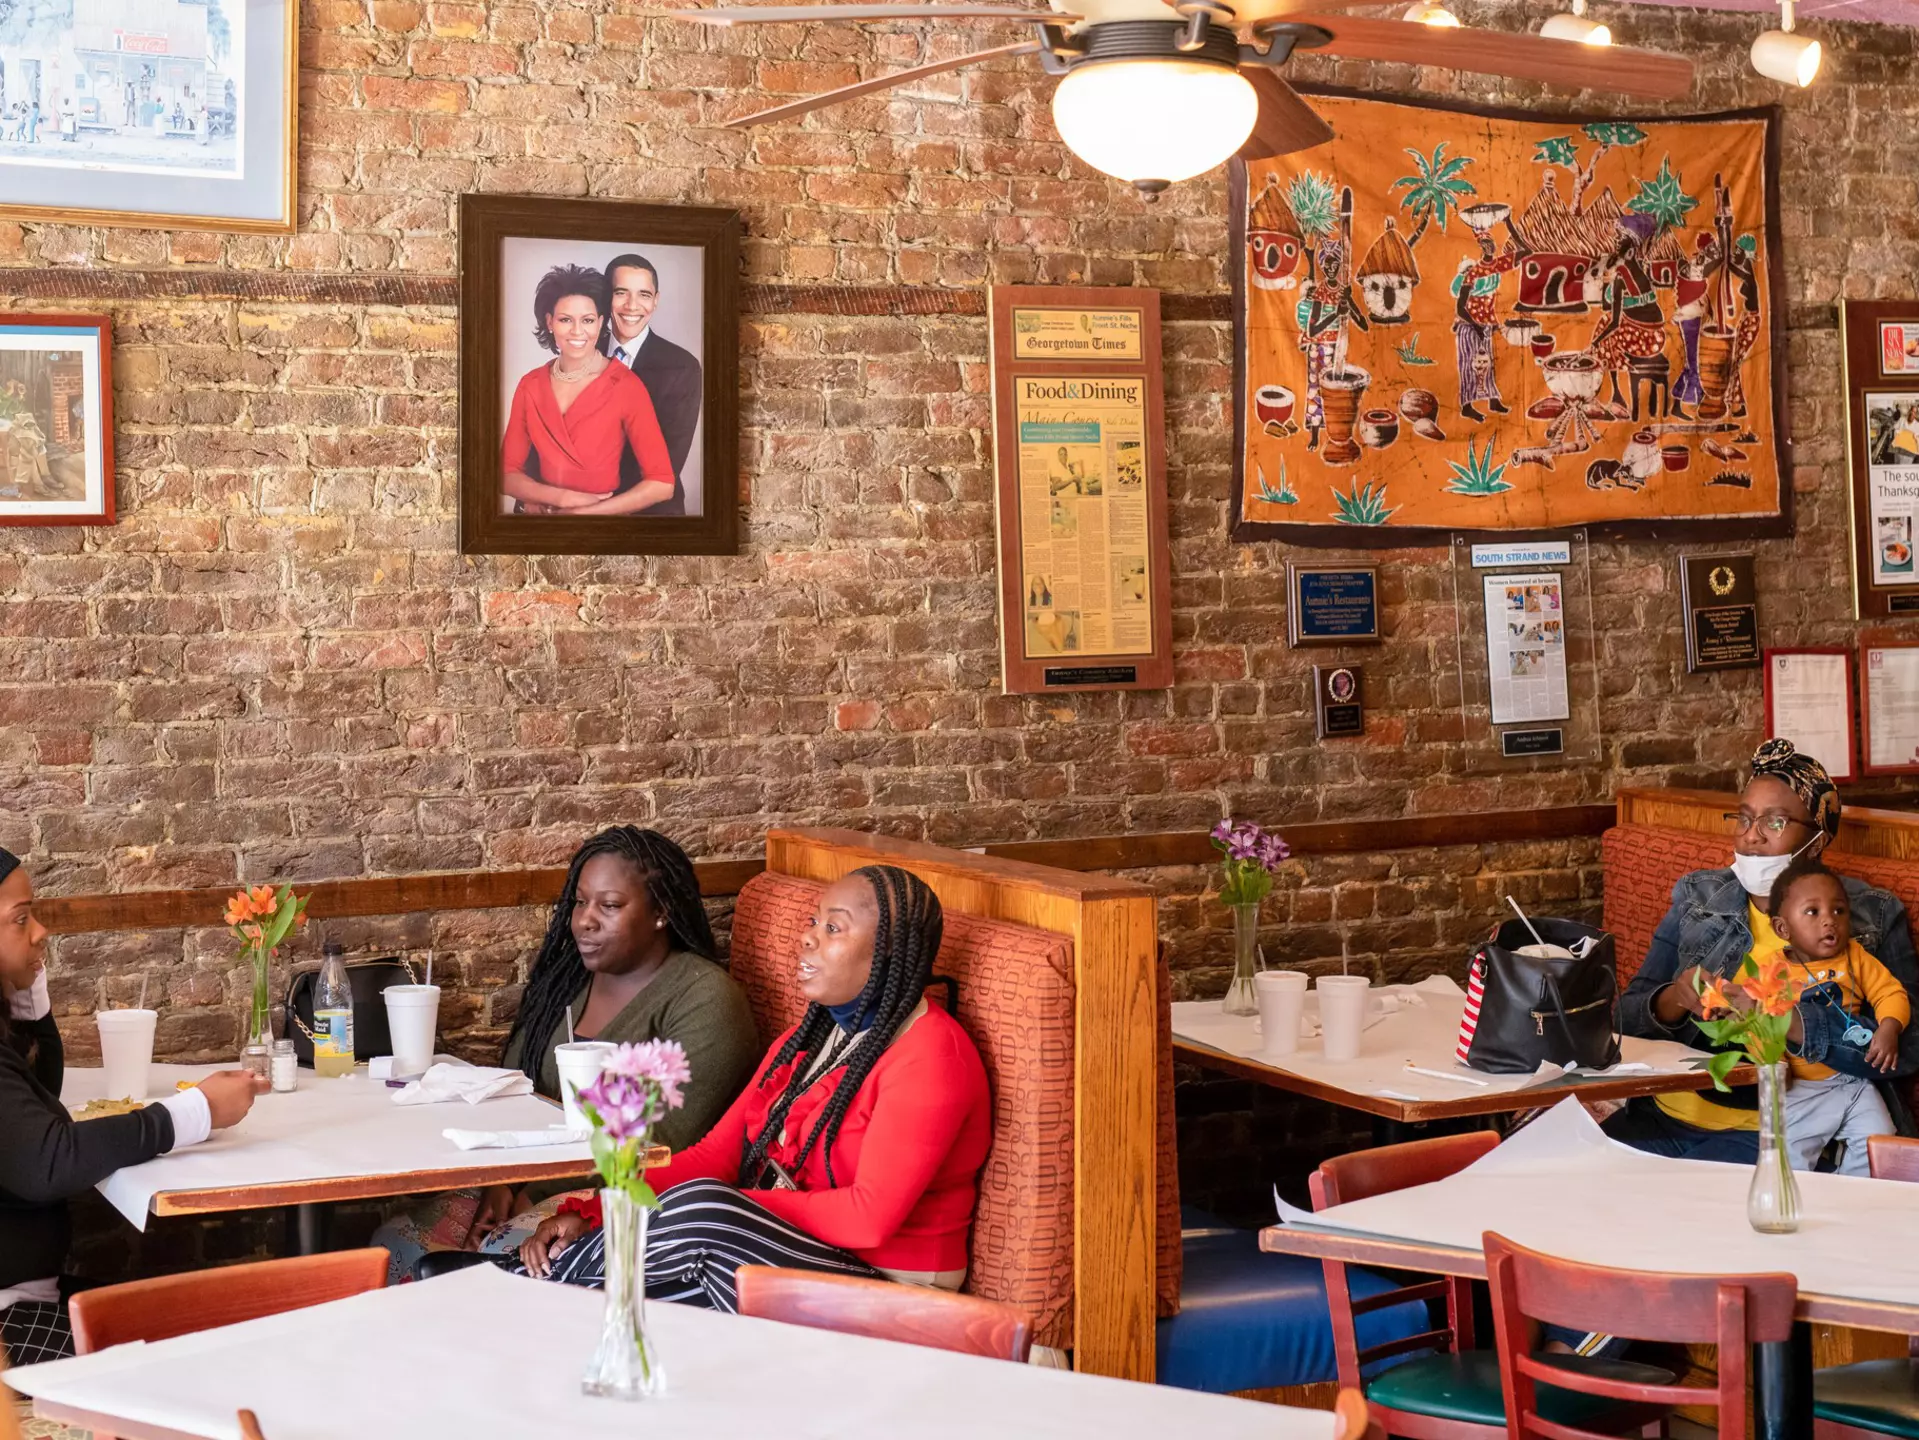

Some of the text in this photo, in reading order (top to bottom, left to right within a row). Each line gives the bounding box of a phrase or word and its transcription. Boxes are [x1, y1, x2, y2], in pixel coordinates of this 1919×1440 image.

[1026, 337, 1126, 350] Georgetown Times
[1883, 471, 1901, 482] The
[1475, 551, 1567, 563] SOUTH STRAND NEWS
